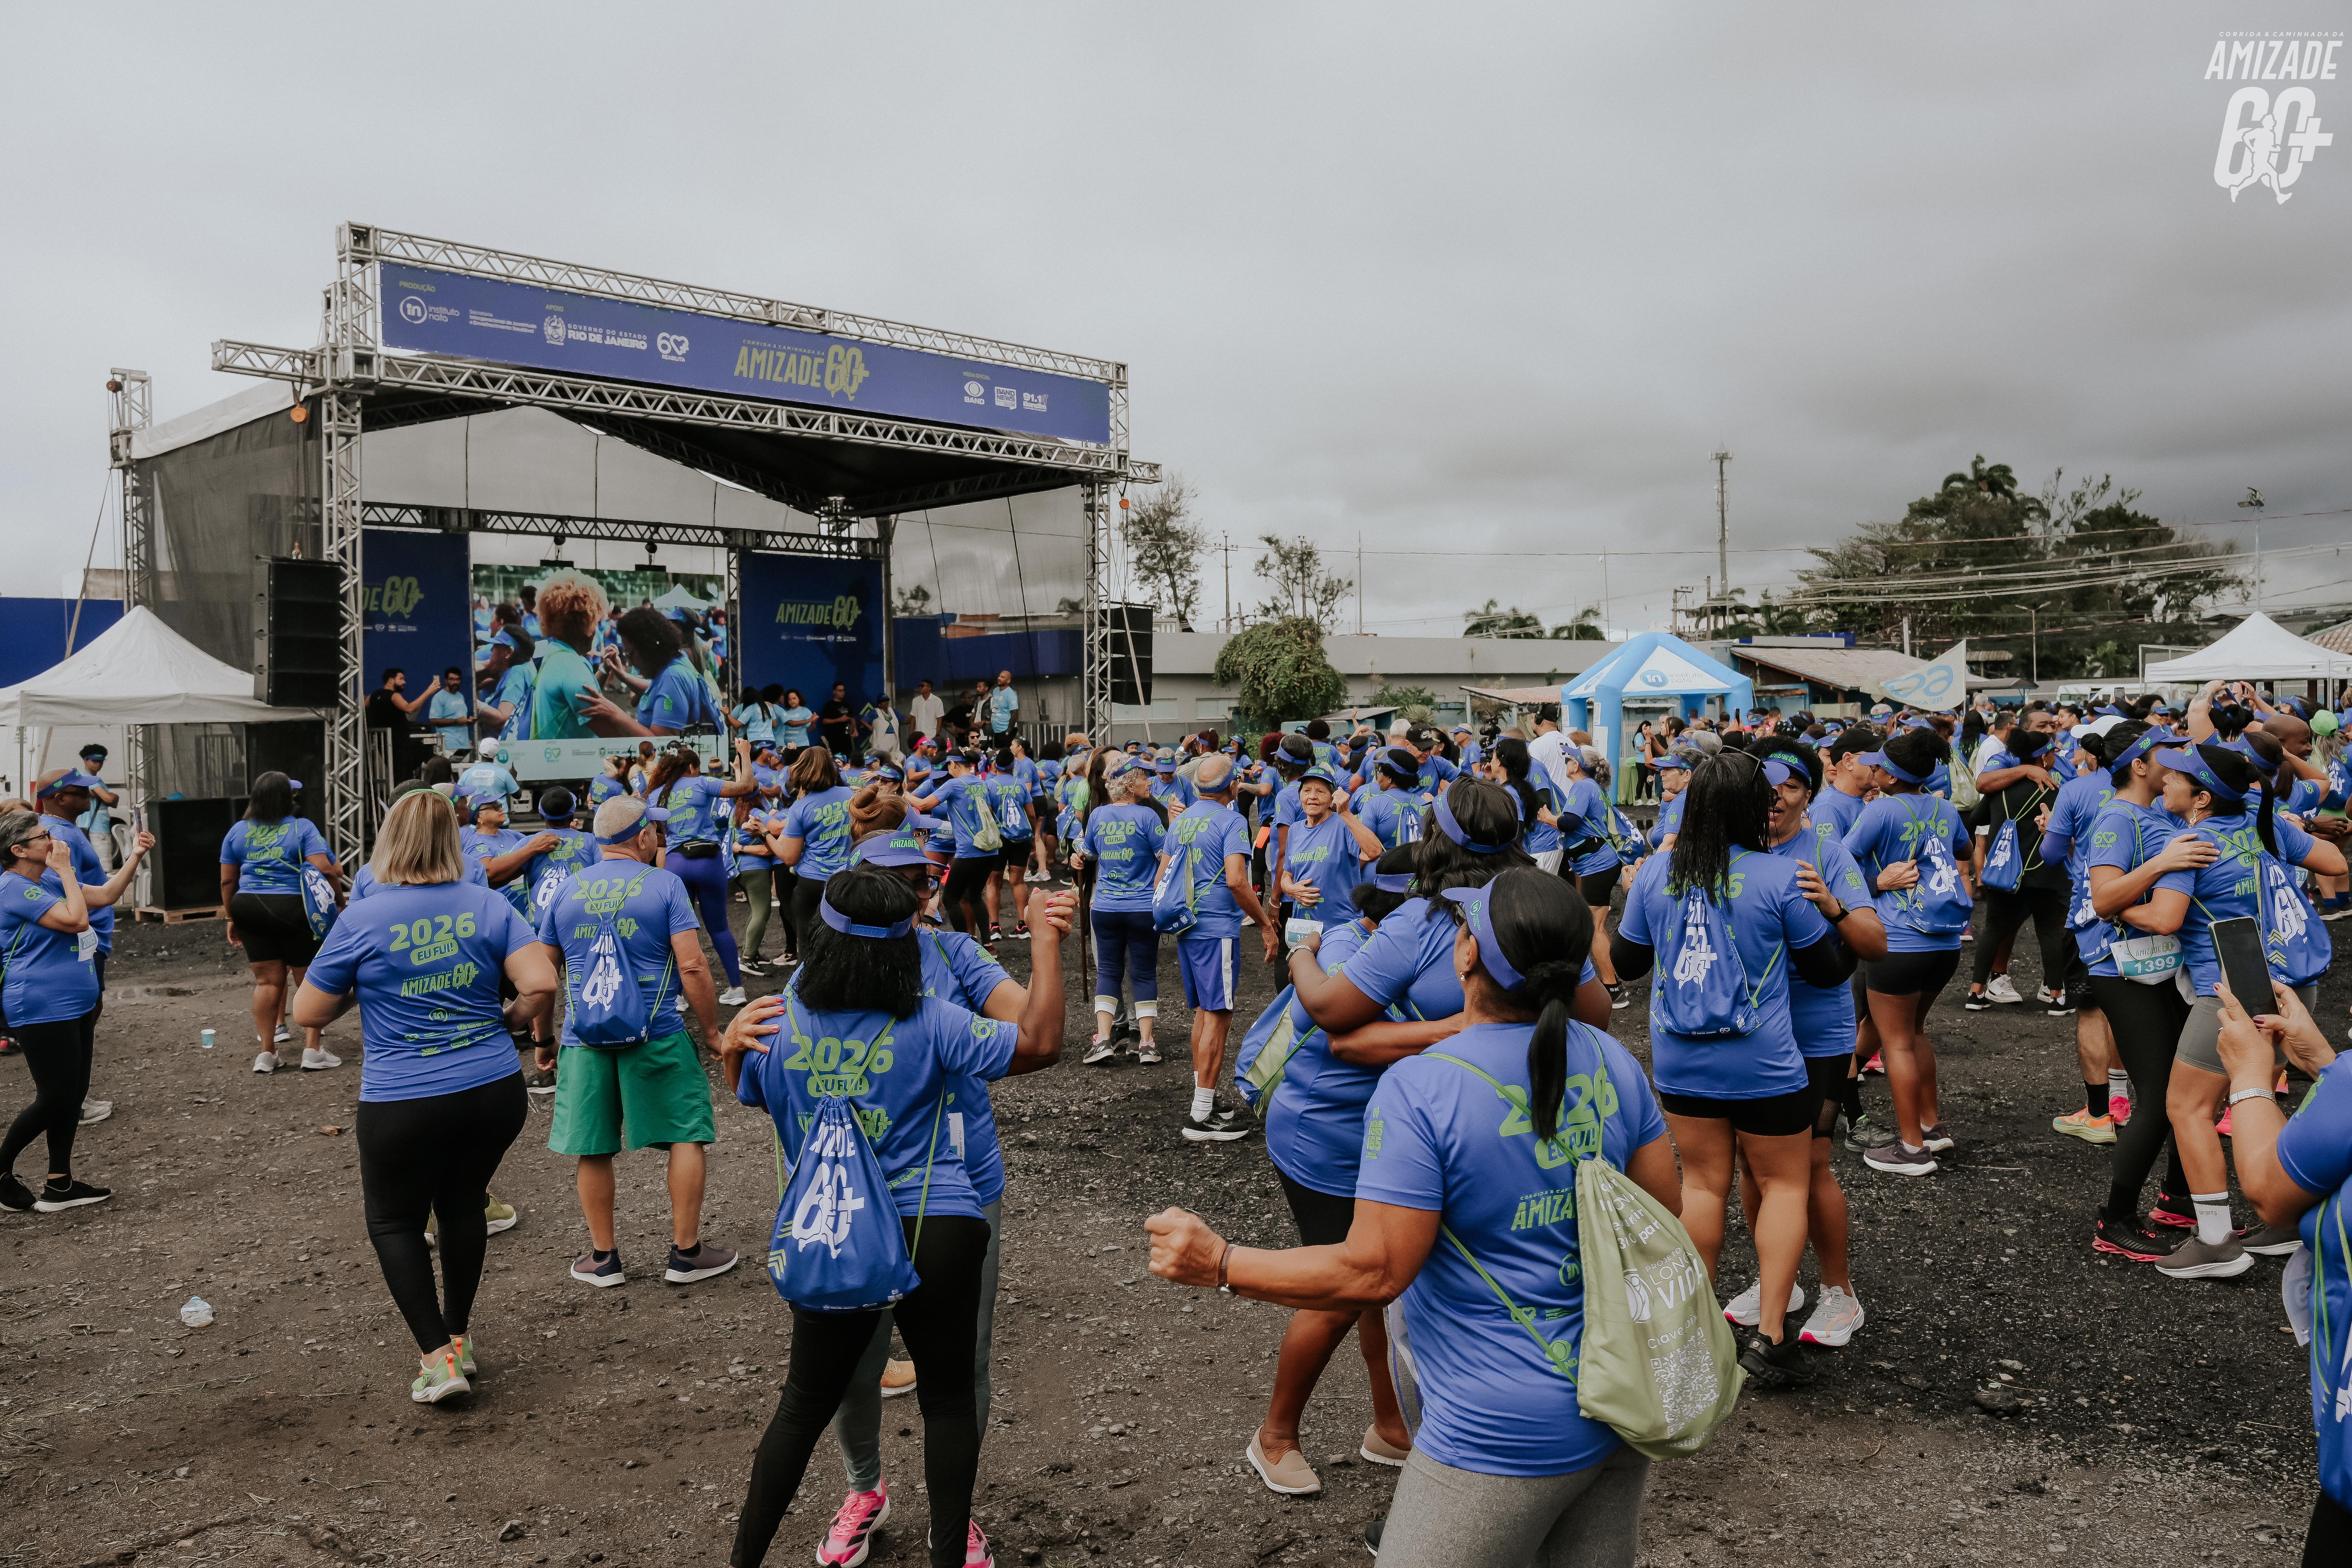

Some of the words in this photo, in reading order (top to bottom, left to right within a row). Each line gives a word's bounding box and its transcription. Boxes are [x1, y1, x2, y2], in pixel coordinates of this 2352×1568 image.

[568, 324, 604, 334] GOVERNO
[619, 331, 648, 340] ESTADO
[568, 330, 588, 341] RIO
[588, 333, 603, 344] DE
[604, 336, 648, 350] JANEIRO
[733, 346, 824, 388] AMIZADE
[964, 396, 985, 405] BAND
[776, 602, 832, 625] AMIZADE
[668, 786, 694, 803] 026
[996, 785, 1021, 795] 2026
[1097, 821, 1136, 835] 2026
[1173, 817, 1212, 835] 2026
[556, 837, 584, 850] 26
[889, 838, 915, 849] AMIZADE
[2217, 826, 2265, 859] 202
[571, 878, 644, 900] 2026
[389, 911, 476, 952] 2026
[574, 926, 598, 939] AMIZ
[417, 949, 431, 961] EU
[433, 942, 454, 957] FUI!
[2134, 956, 2175, 973] 1399
[401, 973, 452, 997] AMIZADE
[784, 1034, 894, 1073] 2026
[1496, 1067, 1619, 1138] 226
[1520, 1190, 1549, 1200] CORRIDA
[1511, 1193, 1578, 1231] AMIZA
[1644, 1247, 1682, 1273] PROJETO
